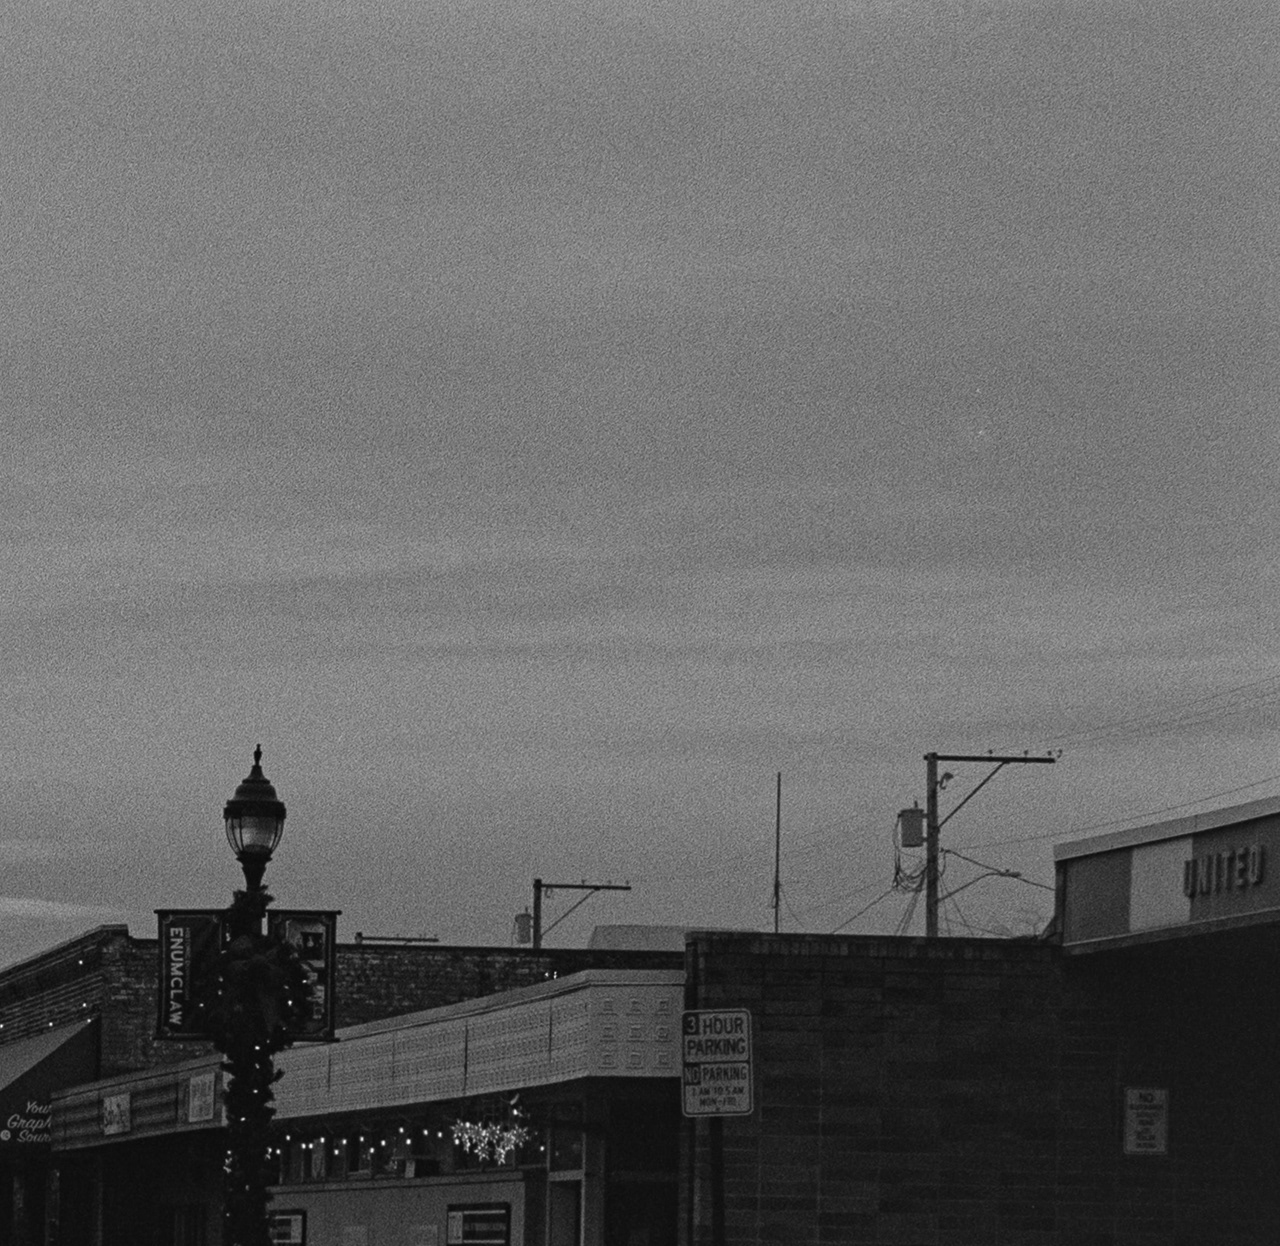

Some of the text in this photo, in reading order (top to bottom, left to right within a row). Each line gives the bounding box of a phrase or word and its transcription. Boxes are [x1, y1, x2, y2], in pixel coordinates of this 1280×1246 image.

[1183, 845, 1266, 898] UNITED
[168, 926, 184, 1026] ENUMCLAW
[686, 1016, 744, 1035] 3 HOUR
[686, 1039, 746, 1056] PARKING
[684, 1065, 748, 1083] NO PARKING
